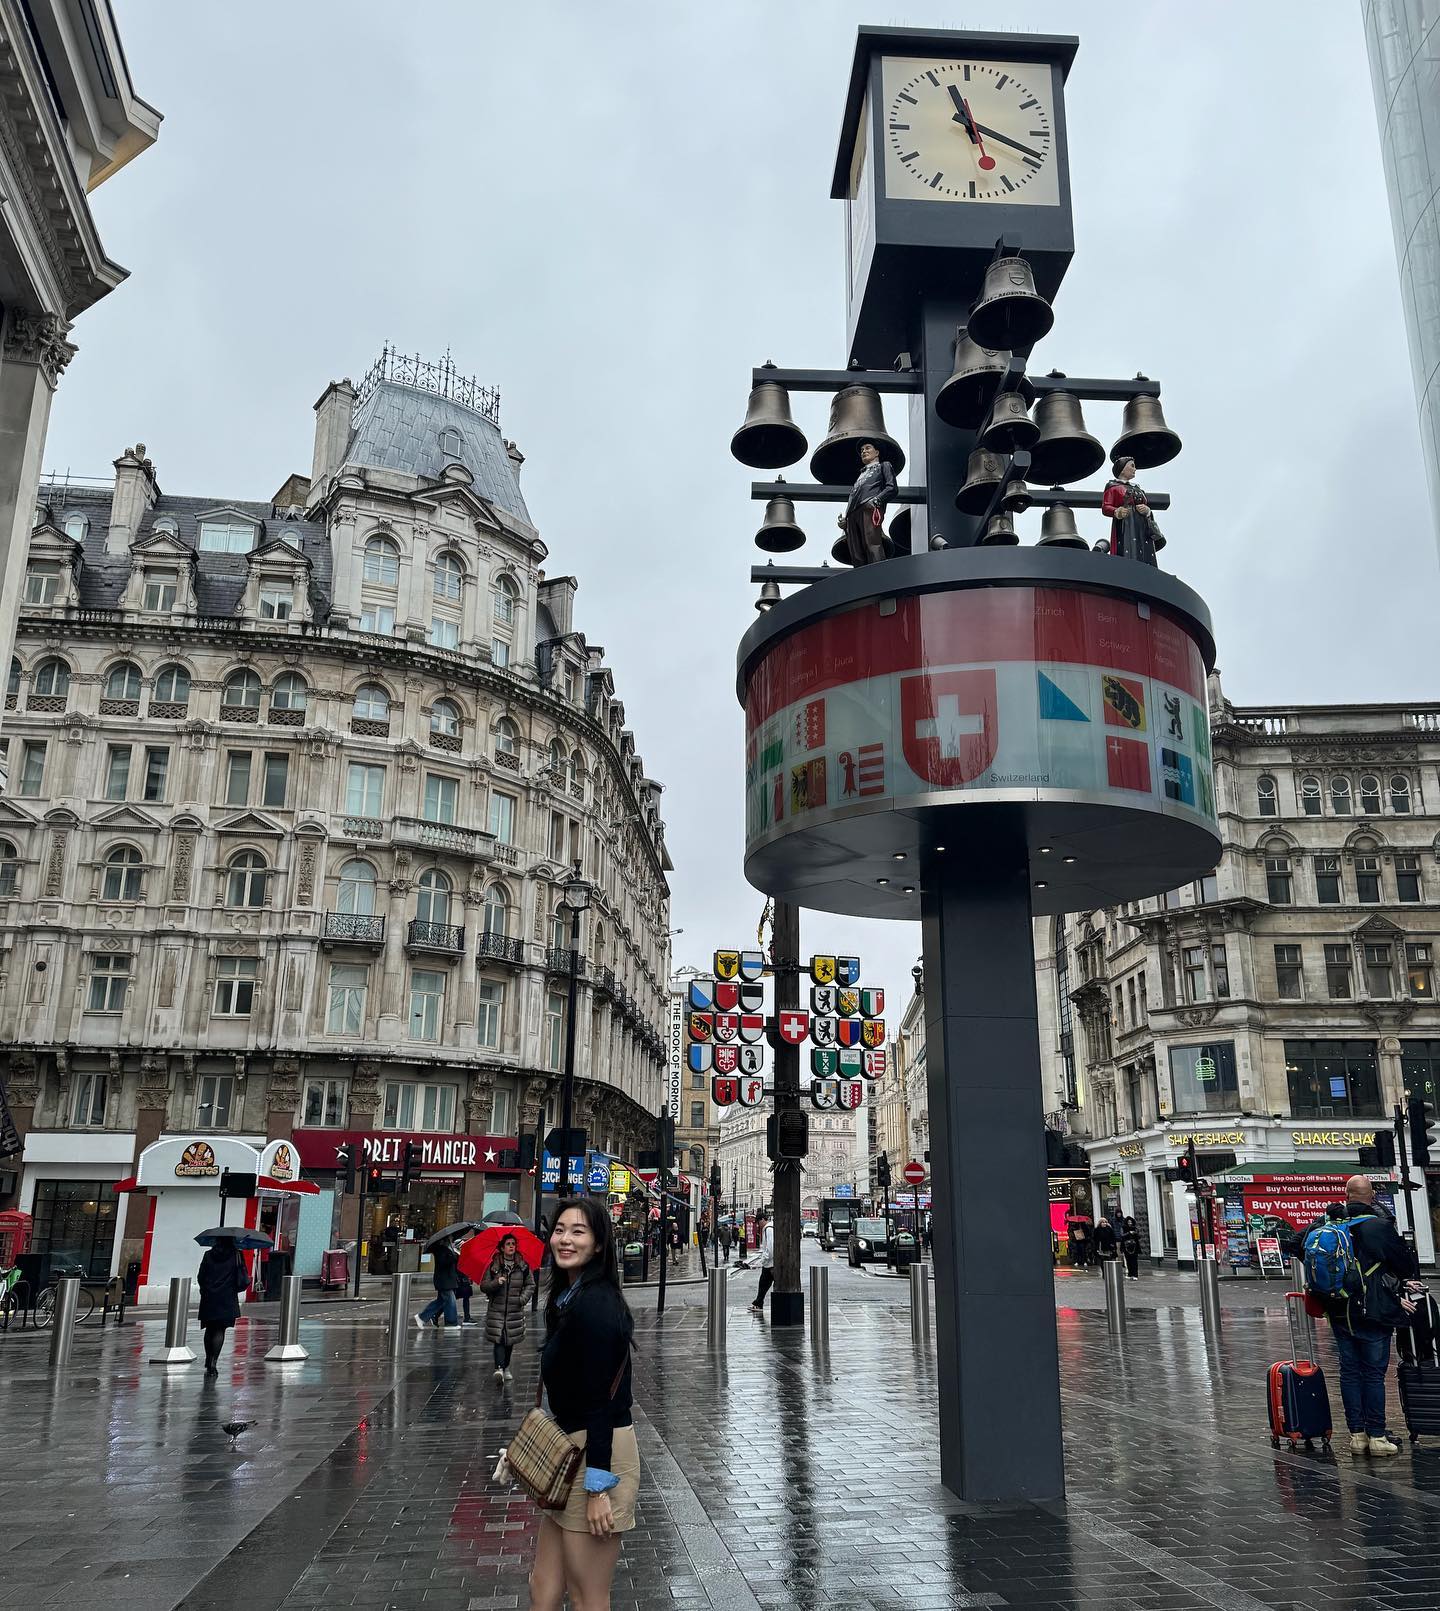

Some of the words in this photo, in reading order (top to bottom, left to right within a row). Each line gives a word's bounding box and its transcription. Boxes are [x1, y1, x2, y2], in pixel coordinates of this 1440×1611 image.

[990, 773, 1050, 783] Switzerland
[673, 1001, 681, 1021] THE
[672, 1024, 681, 1053] BOOK
[671, 1054, 680, 1069] OF
[670, 1071, 680, 1120] MORMON
[1168, 1133, 1204, 1145] SHAKE
[1206, 1132, 1245, 1145] SHACK
[1292, 1132, 1341, 1145] SHAKE
[422, 1139, 476, 1165] MANGER
[546, 1157, 577, 1170] MOEY
[542, 1172, 583, 1184] EXCHNGE
[1252, 1200, 1272, 1212] Buy
[1274, 1200, 1299, 1210] Your
[1300, 1200, 1336, 1209] Ticke
